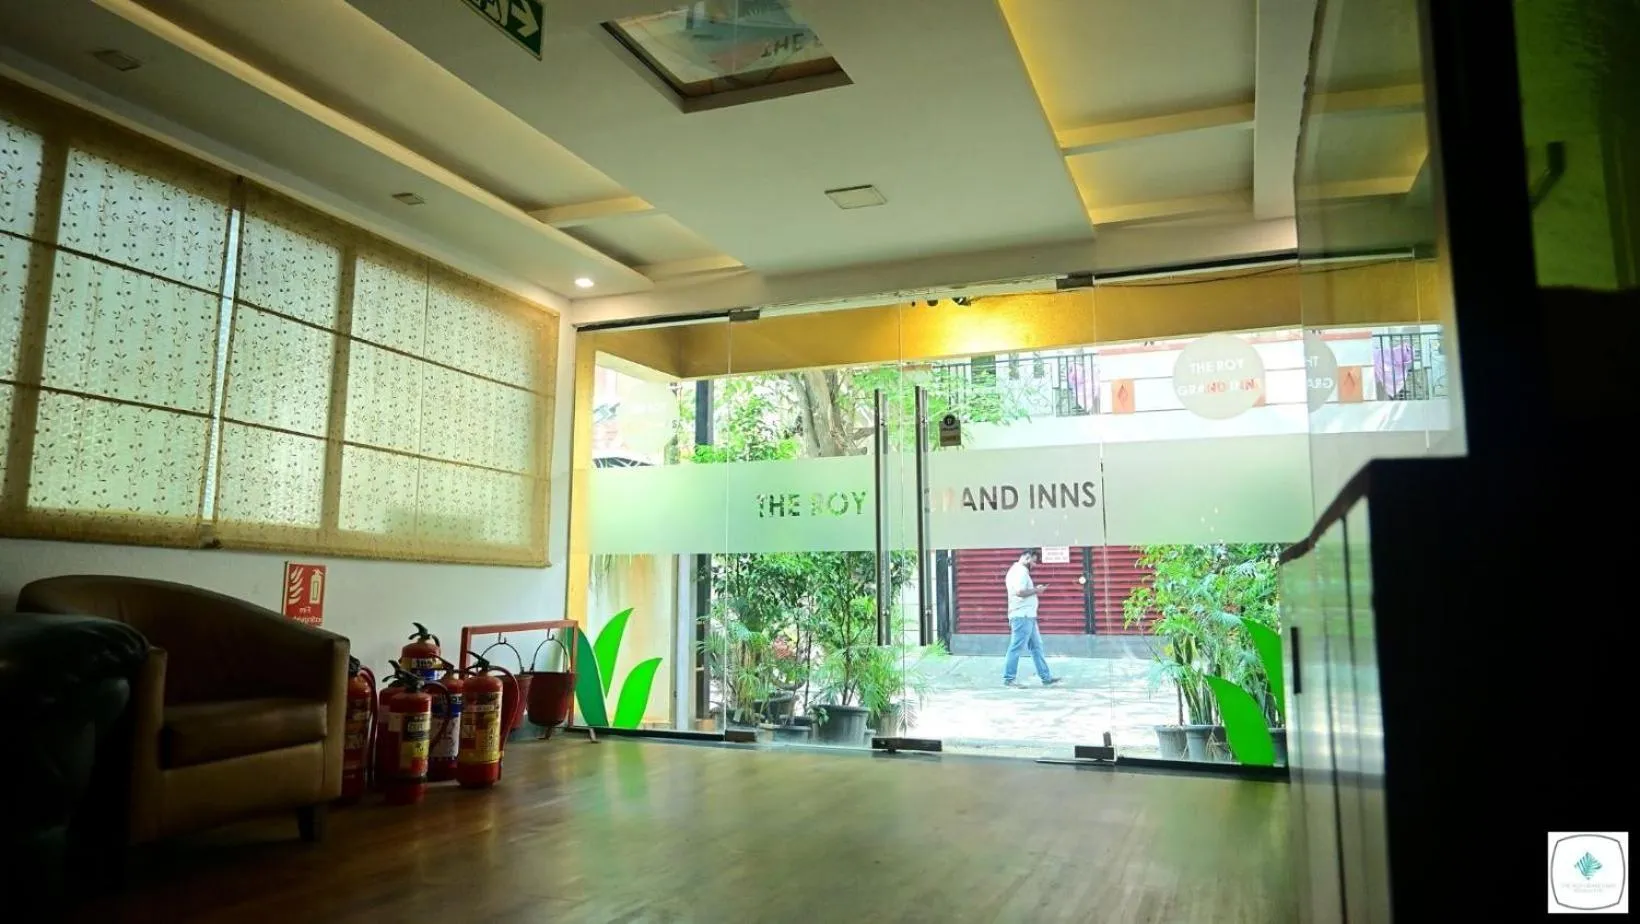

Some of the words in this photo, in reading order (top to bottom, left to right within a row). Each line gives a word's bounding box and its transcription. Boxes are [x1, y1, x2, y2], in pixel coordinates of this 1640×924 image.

[1188, 360, 1215, 374] THE
[1216, 358, 1244, 372] ROY
[1176, 379, 1226, 396] GRAND
[756, 493, 800, 518] THE
[809, 491, 866, 517] ROY
[1029, 481, 1096, 510] INNS
